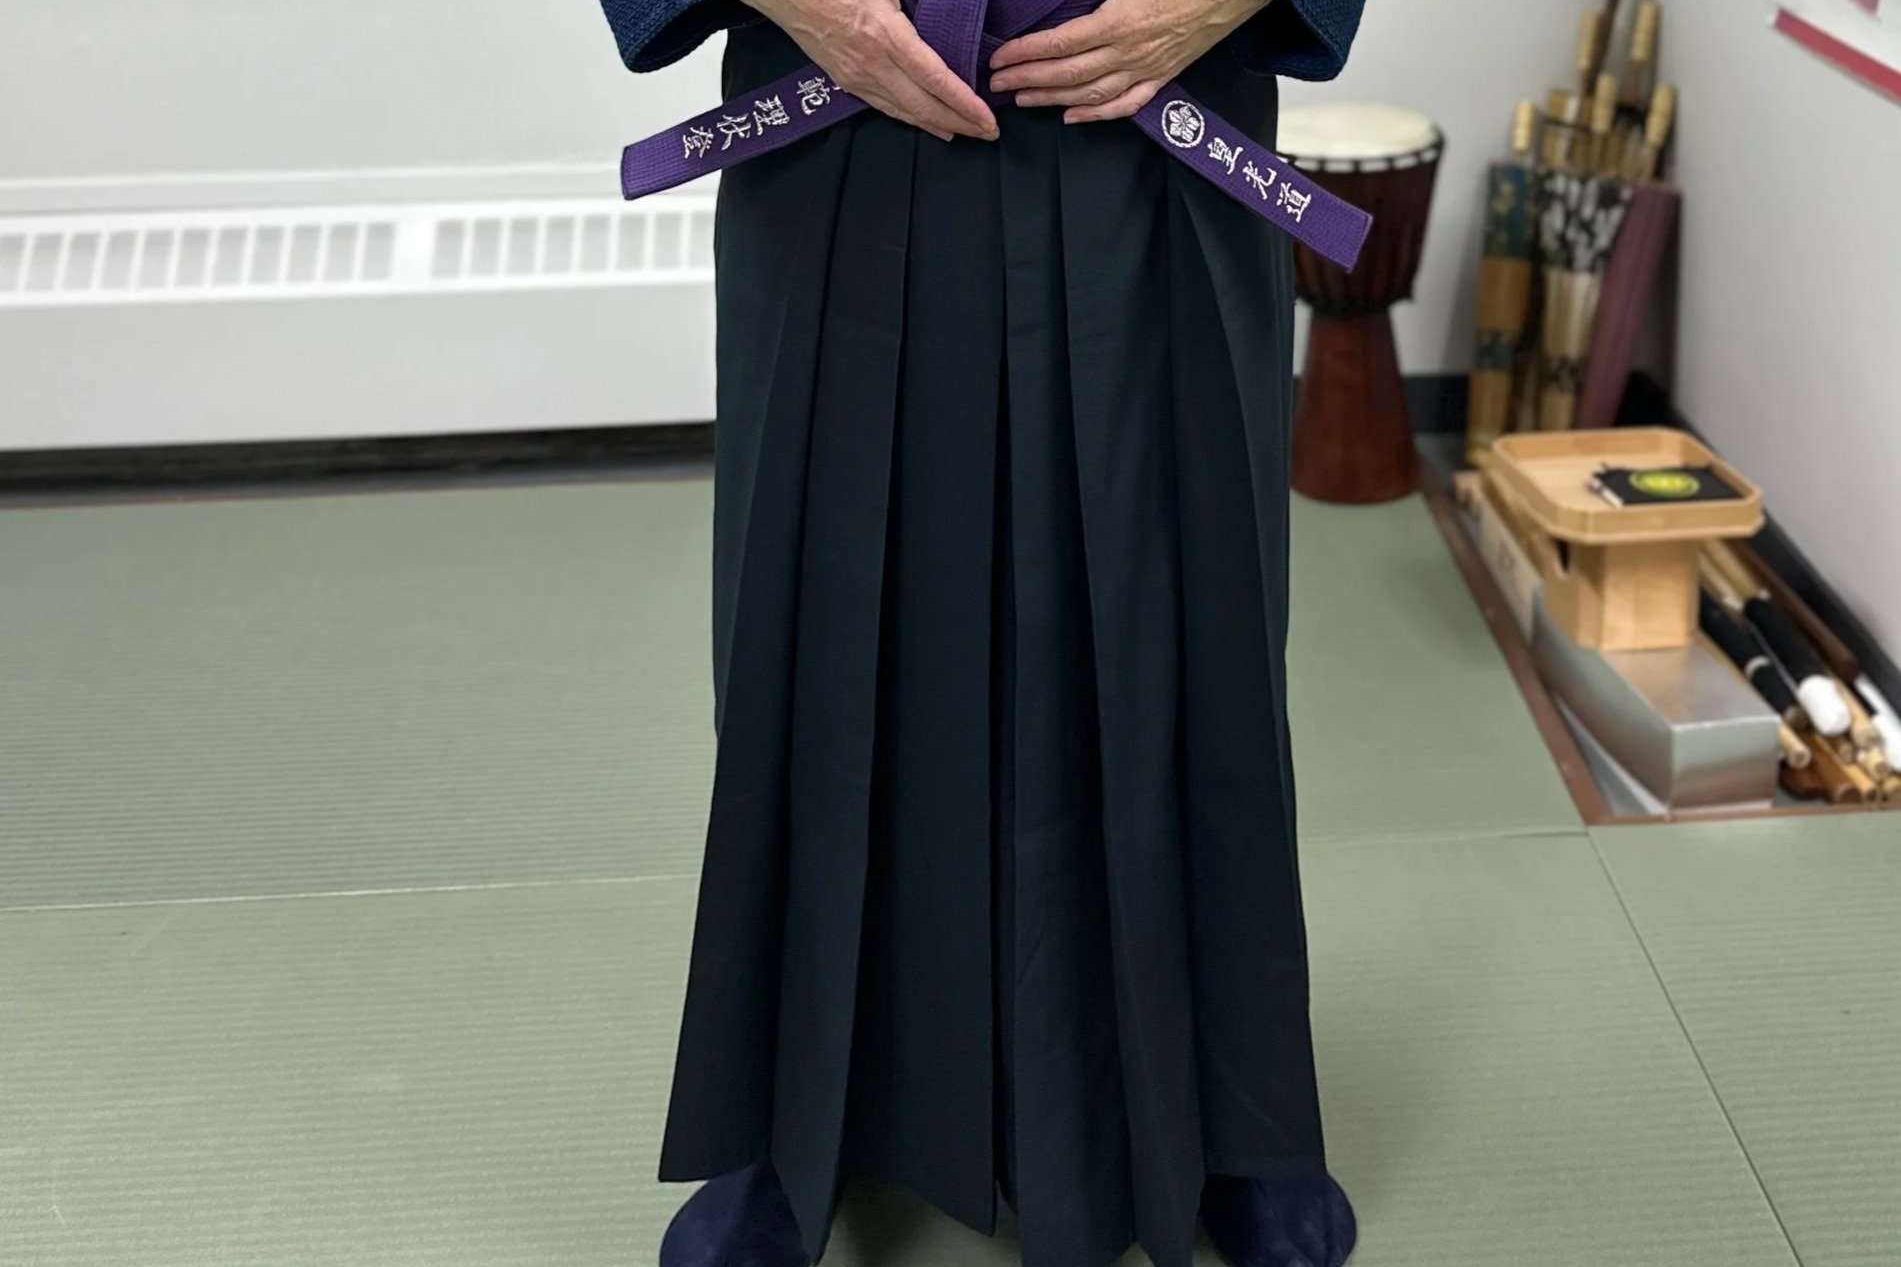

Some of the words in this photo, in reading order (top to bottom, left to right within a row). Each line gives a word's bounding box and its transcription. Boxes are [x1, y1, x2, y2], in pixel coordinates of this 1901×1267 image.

[796, 76, 841, 115] 範
[1207, 137, 1312, 223] 皇光道
